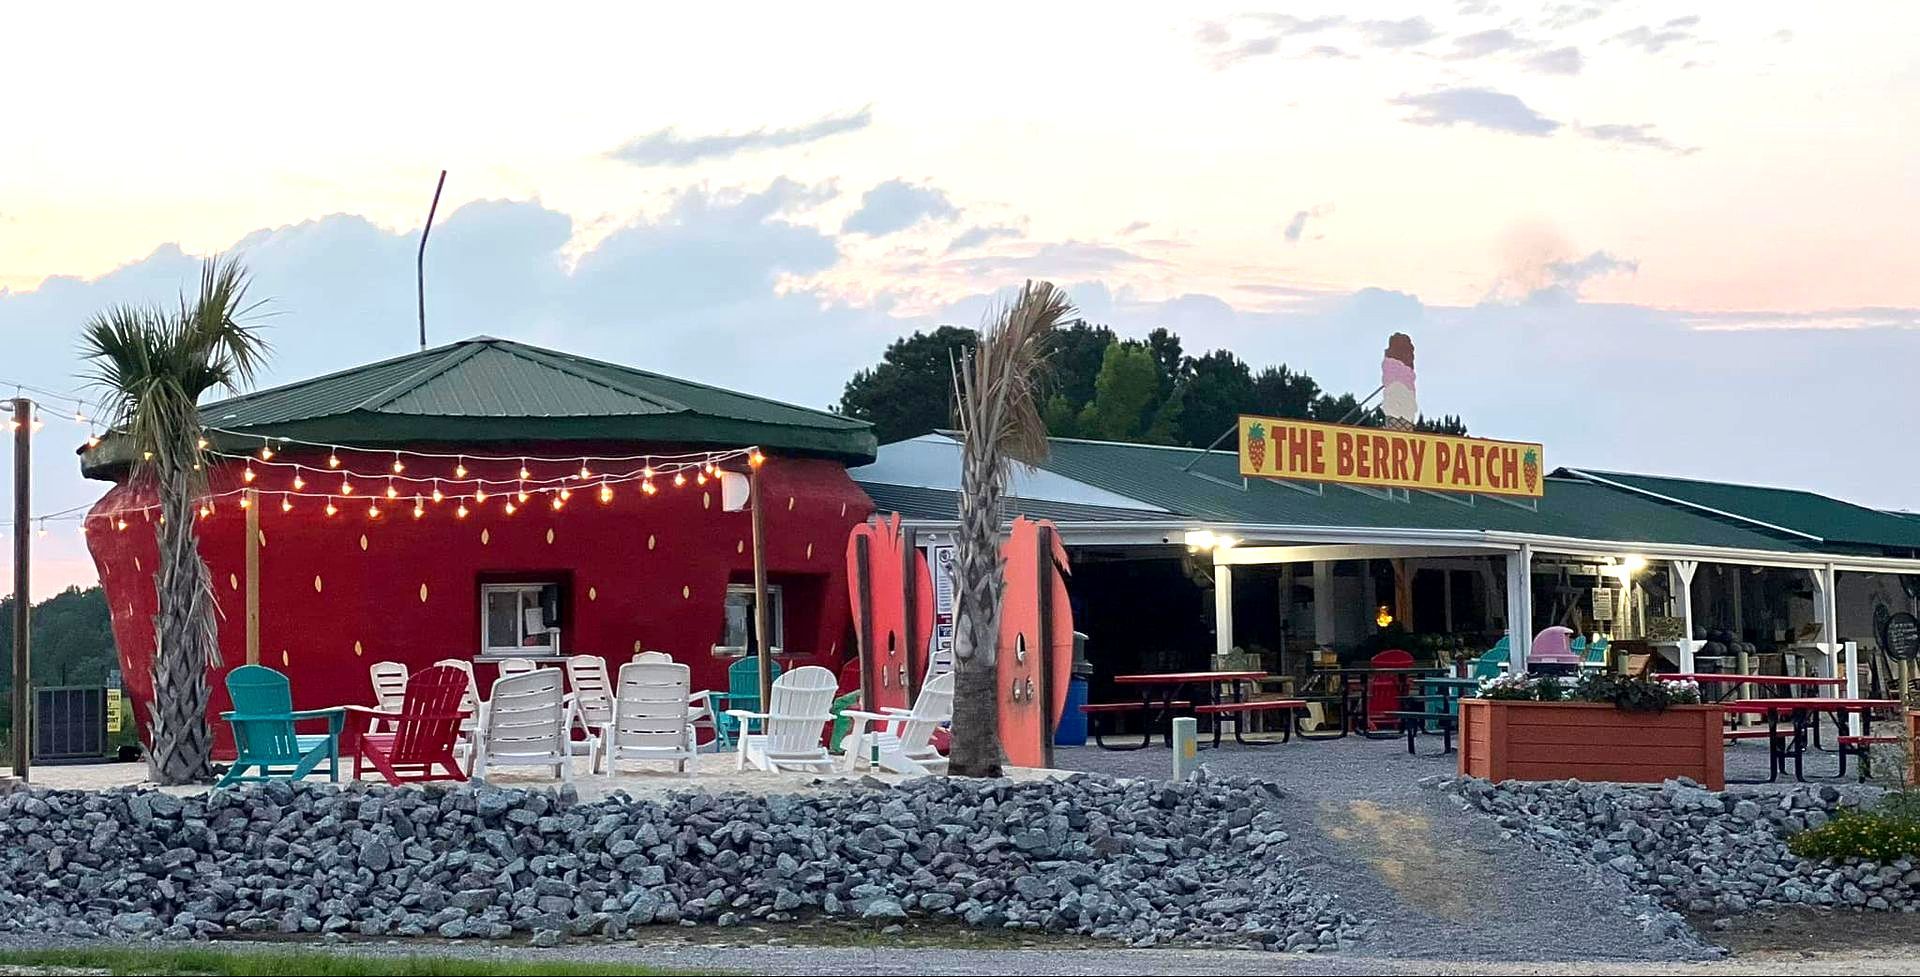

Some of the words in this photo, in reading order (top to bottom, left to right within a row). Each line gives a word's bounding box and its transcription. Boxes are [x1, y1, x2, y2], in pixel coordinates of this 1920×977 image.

[1271, 426, 1325, 474] THE
[1336, 432, 1425, 482] BERRY
[1436, 441, 1519, 489] PATCH
